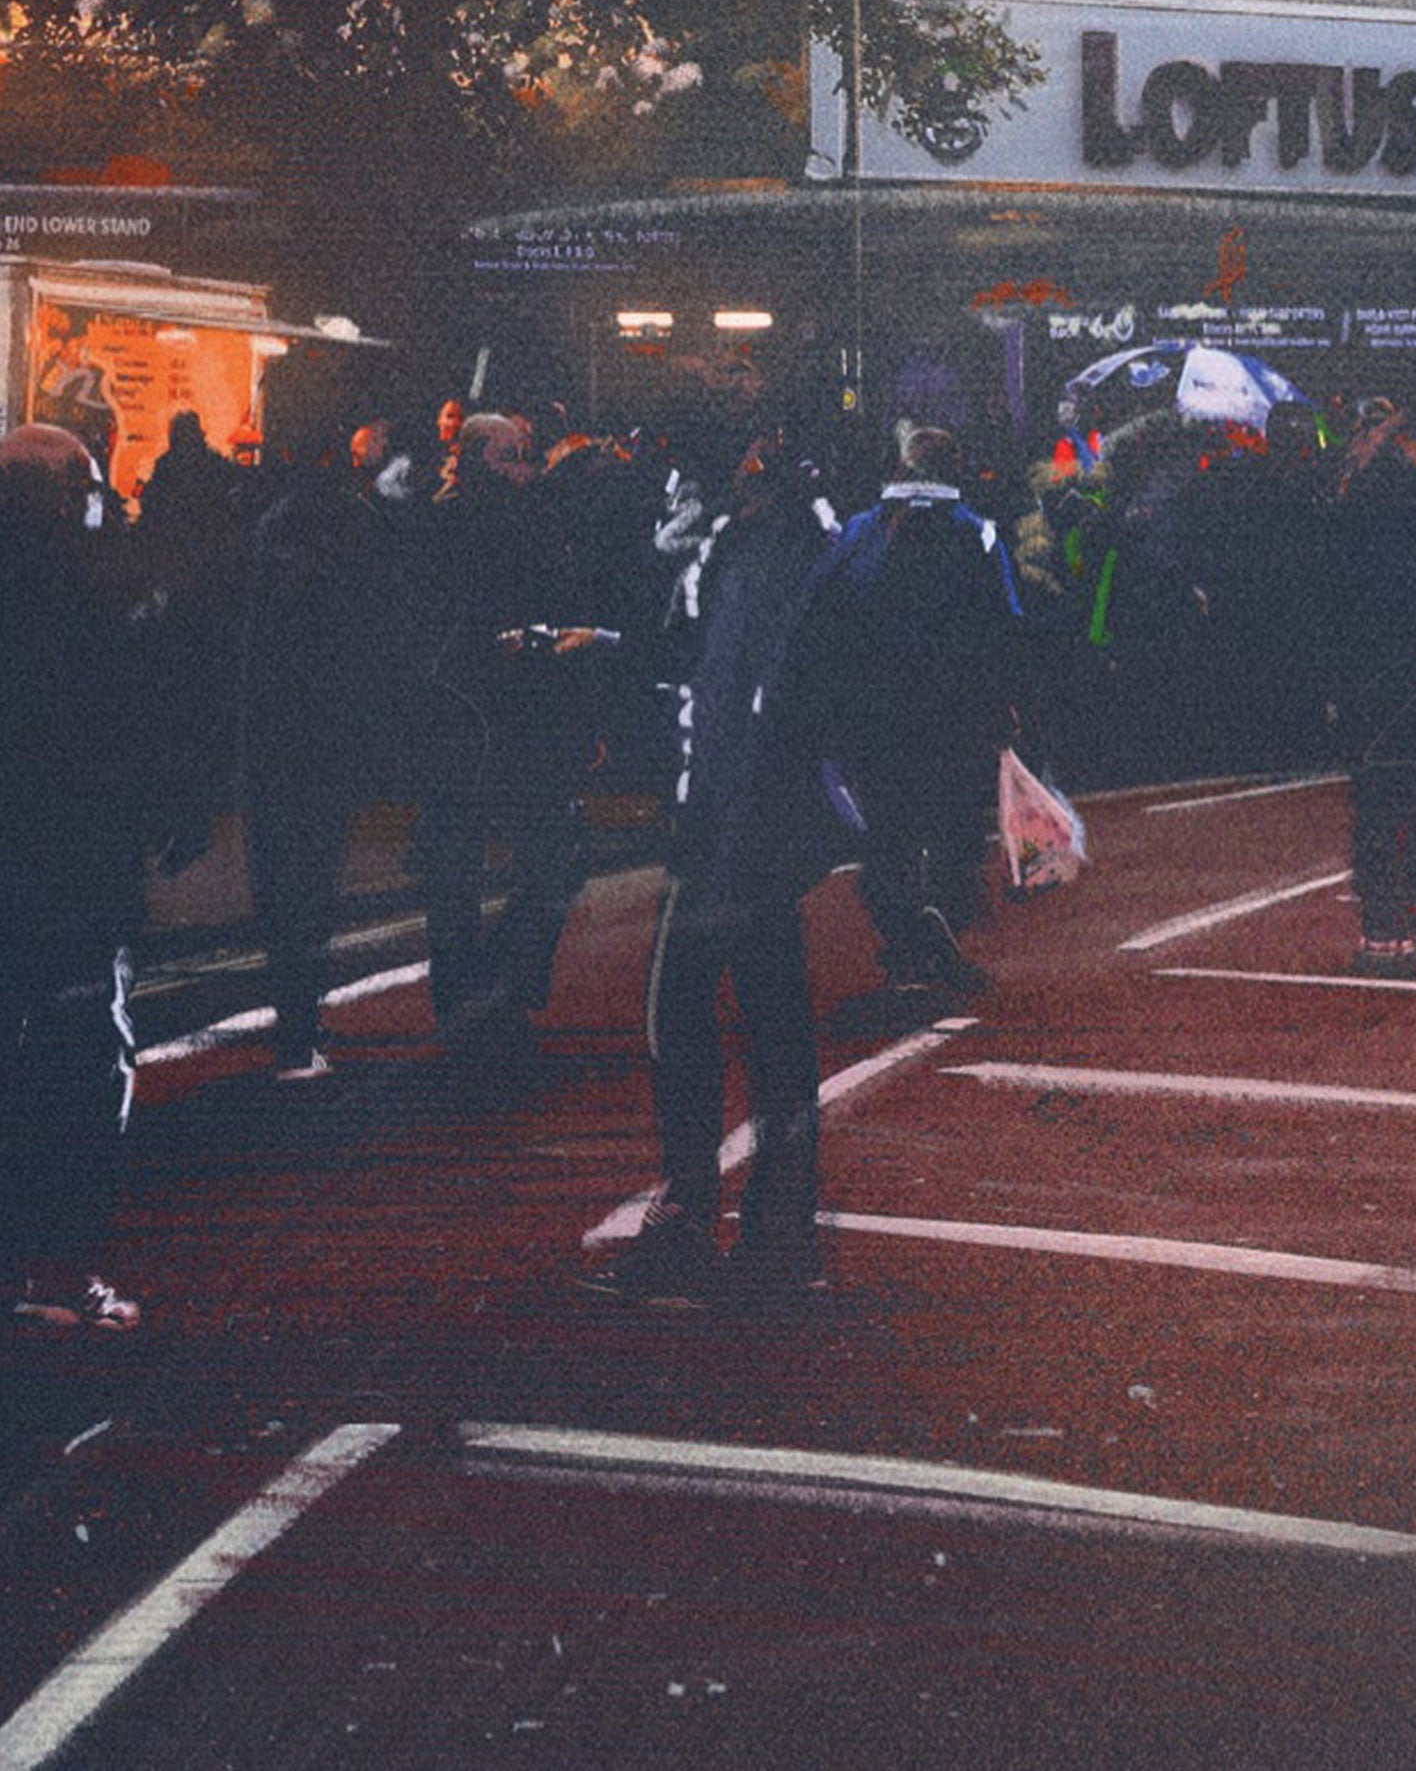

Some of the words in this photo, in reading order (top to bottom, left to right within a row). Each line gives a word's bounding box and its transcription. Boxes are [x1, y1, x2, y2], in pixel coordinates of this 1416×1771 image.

[4, 215, 39, 234] END
[42, 216, 98, 236] LOWER
[100, 217, 152, 237] STAND
